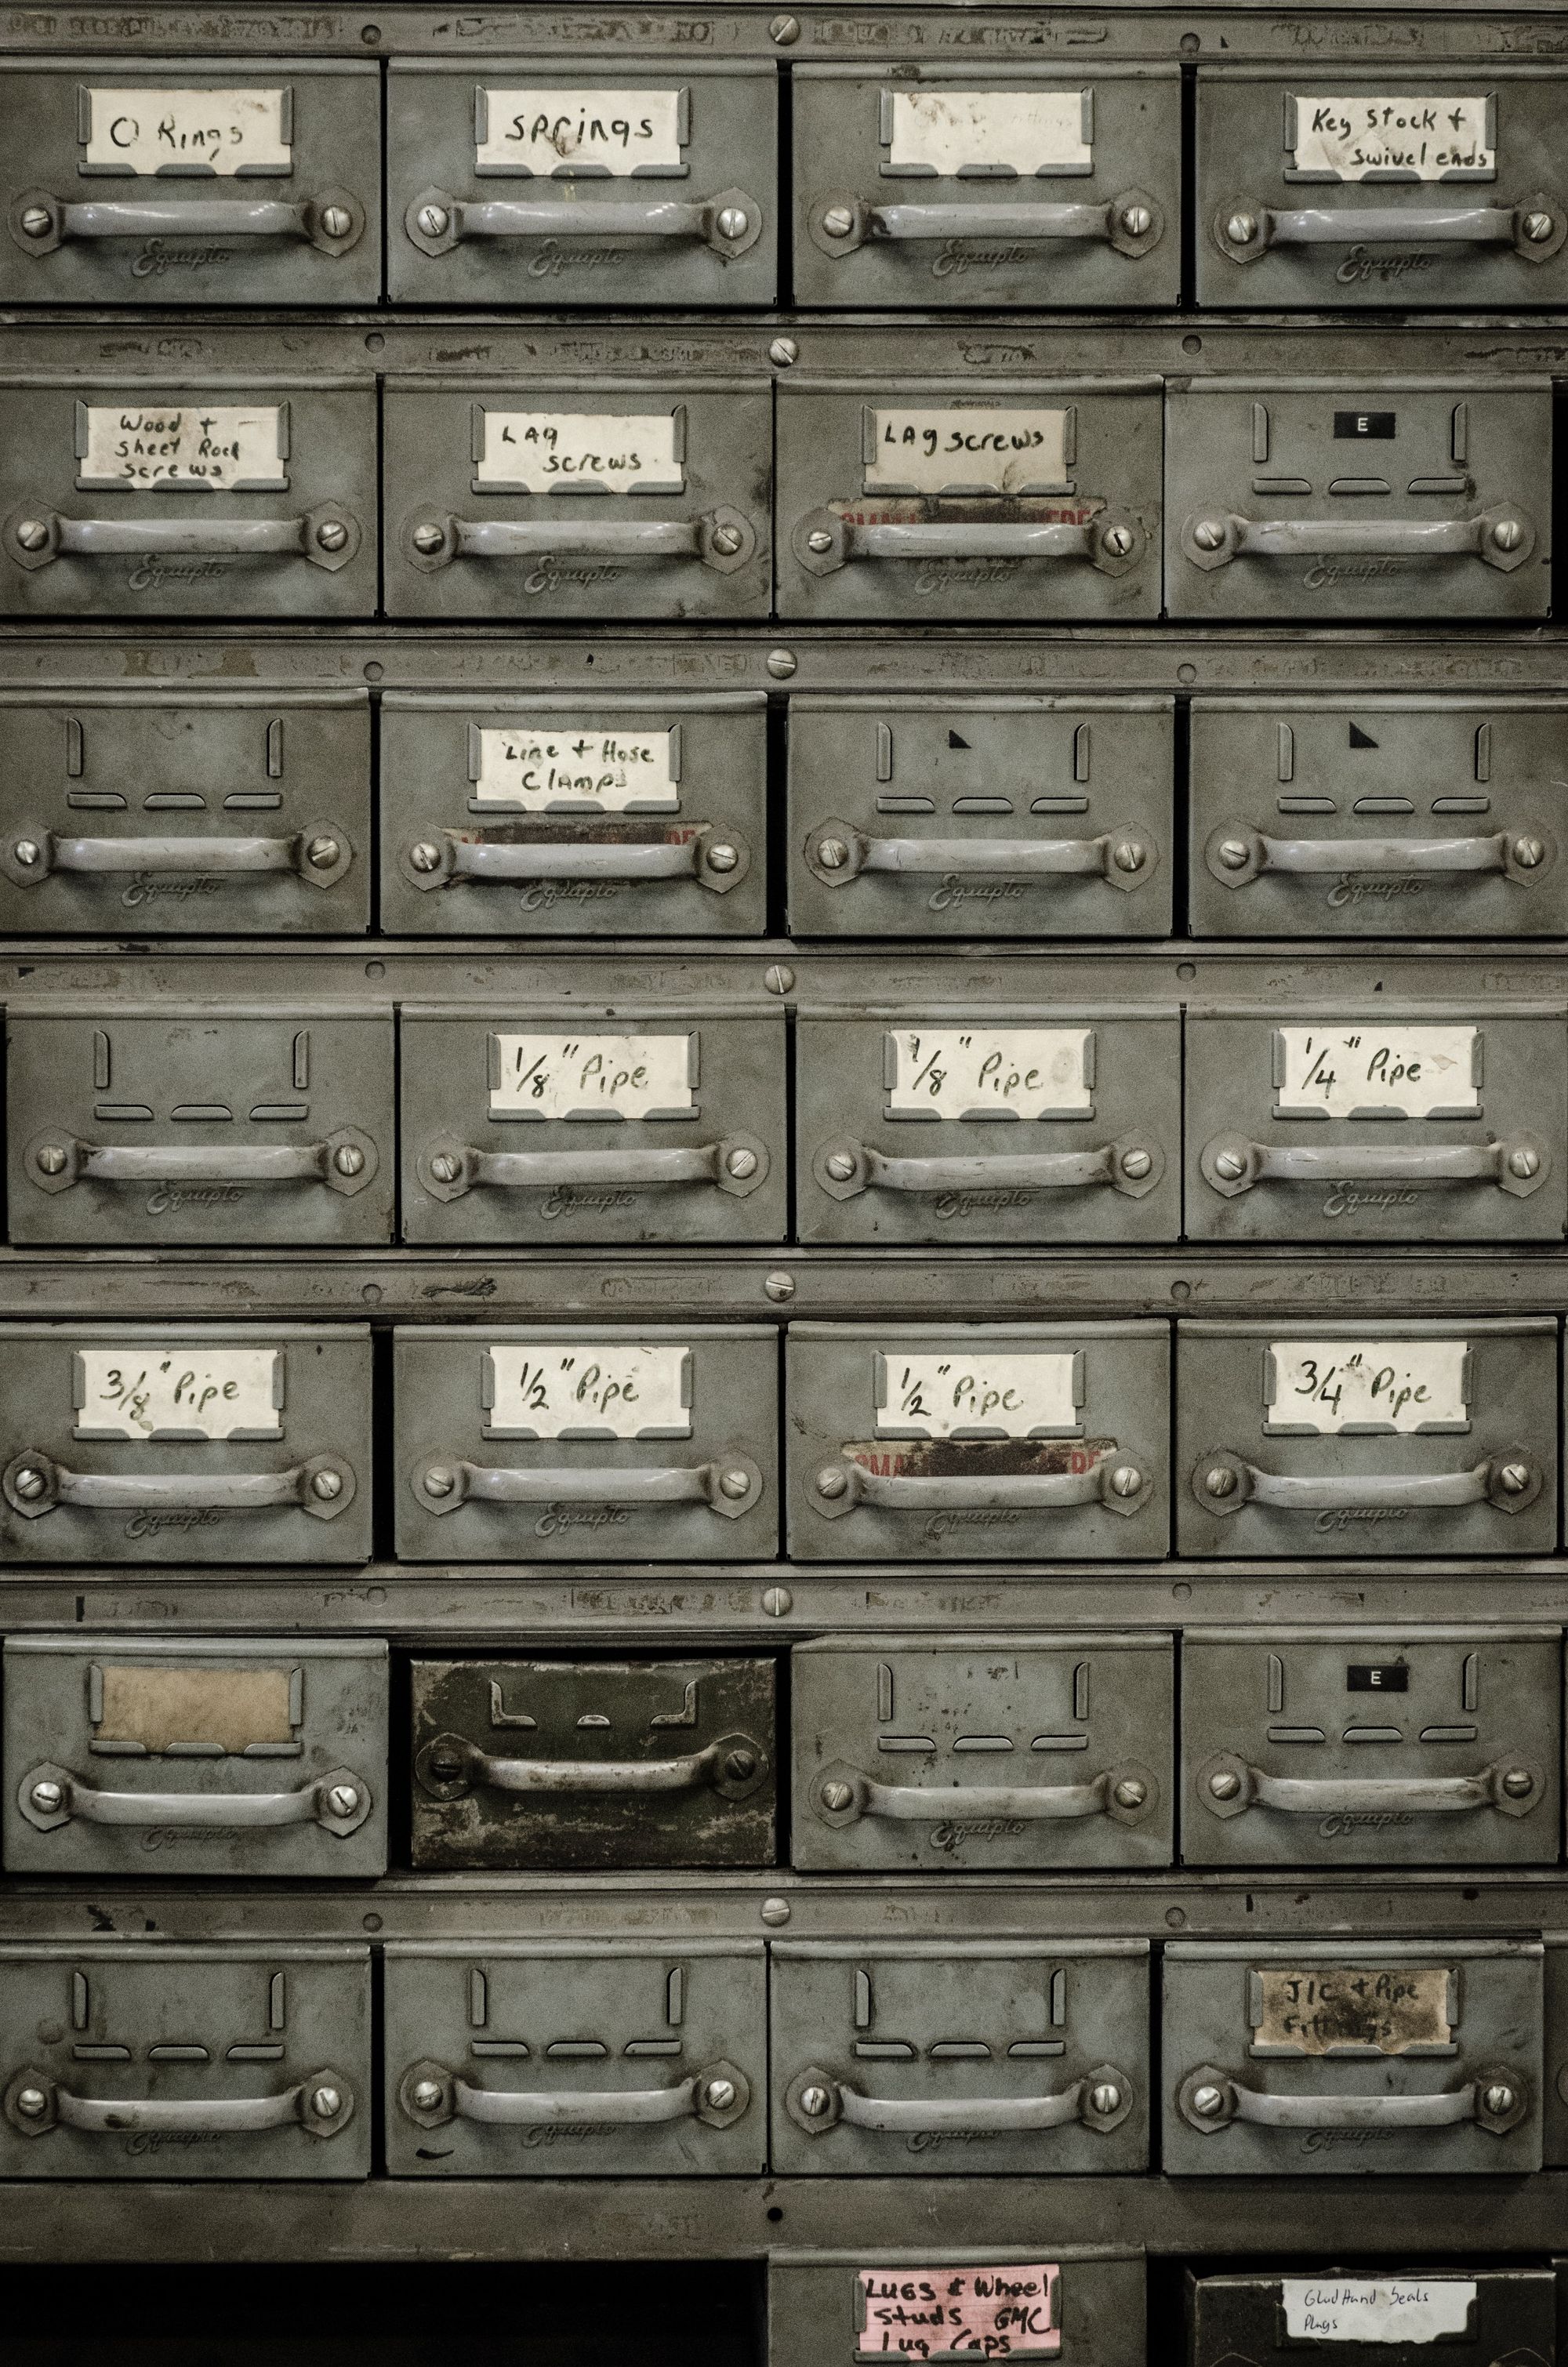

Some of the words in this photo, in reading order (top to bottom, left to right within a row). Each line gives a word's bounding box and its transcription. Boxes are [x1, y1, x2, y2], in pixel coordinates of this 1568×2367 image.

[110, 117, 140, 148] O
[158, 118, 243, 162] Rings
[1312, 107, 1352, 141] Key
[1436, 141, 1490, 172] ends
[120, 412, 182, 434] Wood
[1358, 416, 1369, 432] E
[580, 1054, 646, 1095] Pipe
[978, 1051, 1039, 1096] Pipe
[1367, 1047, 1421, 1087] Pipe
[173, 1371, 237, 1408] Pipe
[576, 1366, 639, 1408] Pipe
[953, 1376, 1015, 1416] Pipe
[1370, 1367, 1427, 1408] Pipe
[1371, 1671, 1382, 1686] E
[995, 2307, 1051, 2335] GMC
